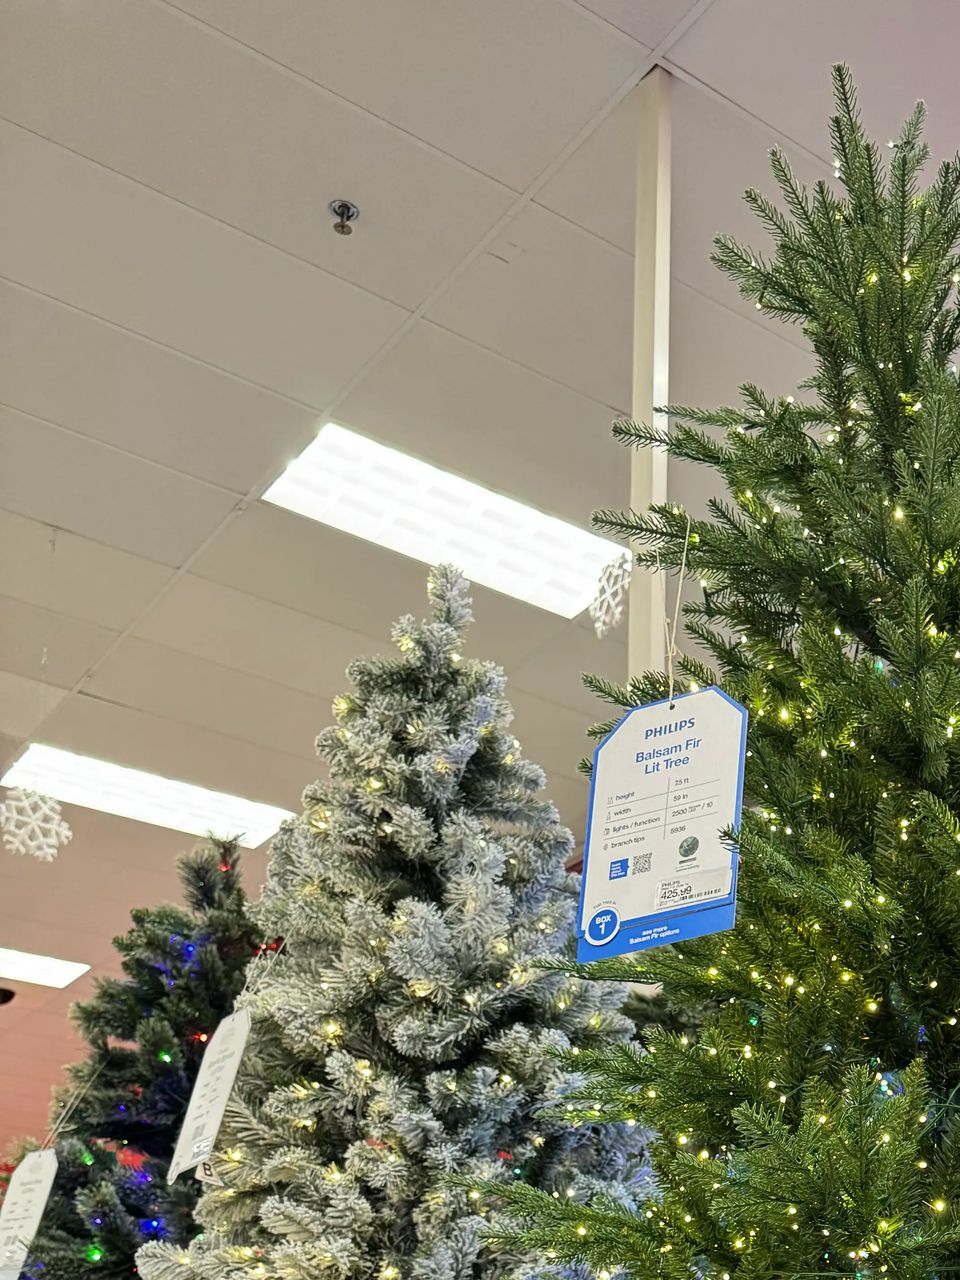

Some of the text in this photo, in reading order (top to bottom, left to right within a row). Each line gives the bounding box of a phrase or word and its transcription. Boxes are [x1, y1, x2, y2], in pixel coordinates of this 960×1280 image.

[645, 717, 695, 740] PHILIPS
[635, 738, 702, 763] Balsam Fir
[645, 756, 690, 774] Lit Tree
[615, 791, 635, 801] height
[614, 807, 632, 816] width
[671, 808, 688, 817] 2500
[612, 824, 629, 833] lights
[634, 816, 661, 827] function
[611, 836, 645, 849] branch tips
[661, 885, 692, 900] 425.99
[595, 914, 612, 924] BOX
[599, 923, 606, 935] 1
[642, 926, 668, 936] see more
[629, 928, 680, 945] Balsam Fir options
